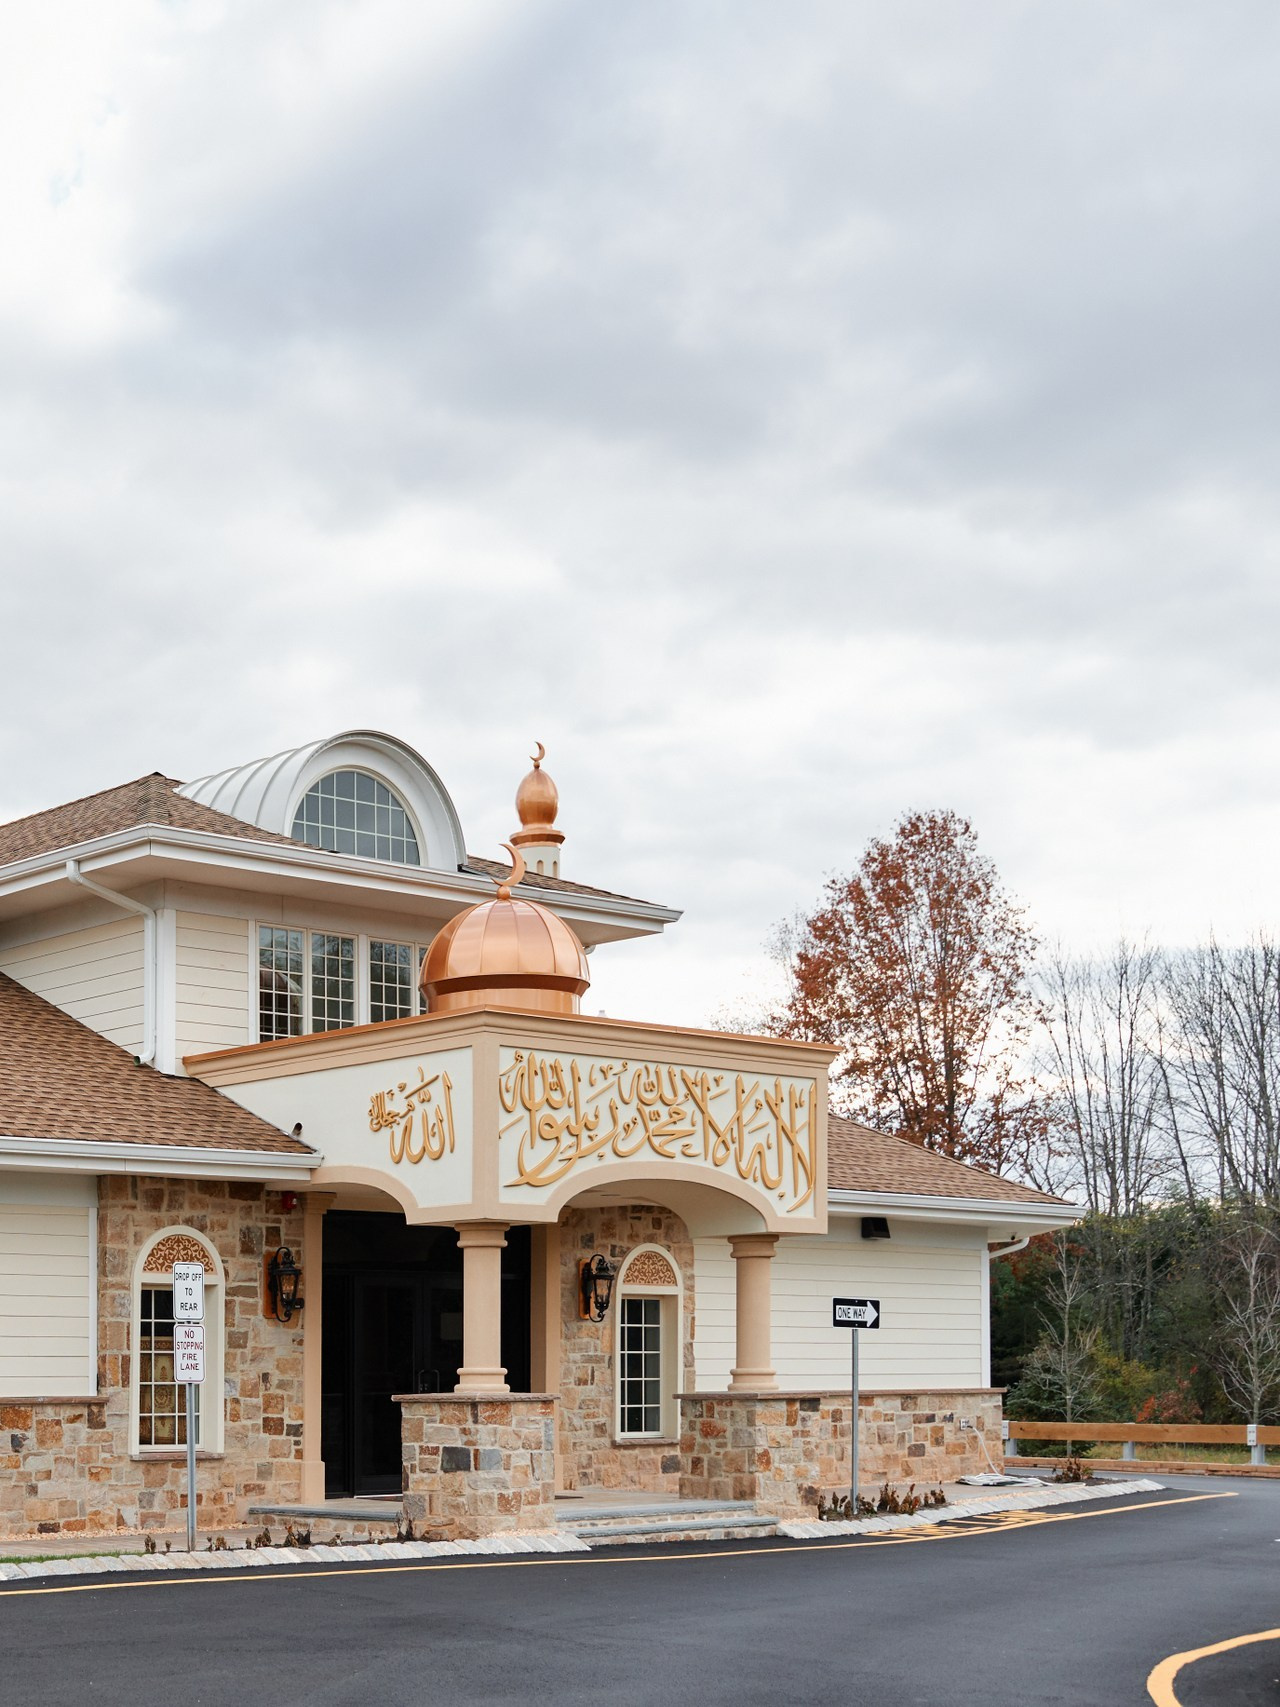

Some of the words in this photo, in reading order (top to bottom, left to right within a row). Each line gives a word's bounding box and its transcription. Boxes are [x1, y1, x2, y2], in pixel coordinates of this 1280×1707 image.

[175, 1272, 190, 1281] DROP
[191, 1273, 202, 1281] OFF
[184, 1287, 193, 1296] TO
[180, 1302, 198, 1311] REAR
[837, 1306, 851, 1319] ONE
[852, 1307, 867, 1319] WAY
[184, 1330, 195, 1339] NO
[176, 1341, 204, 1350] STOPPING
[181, 1353, 198, 1361] FIRE
[180, 1363, 200, 1371] LANE
